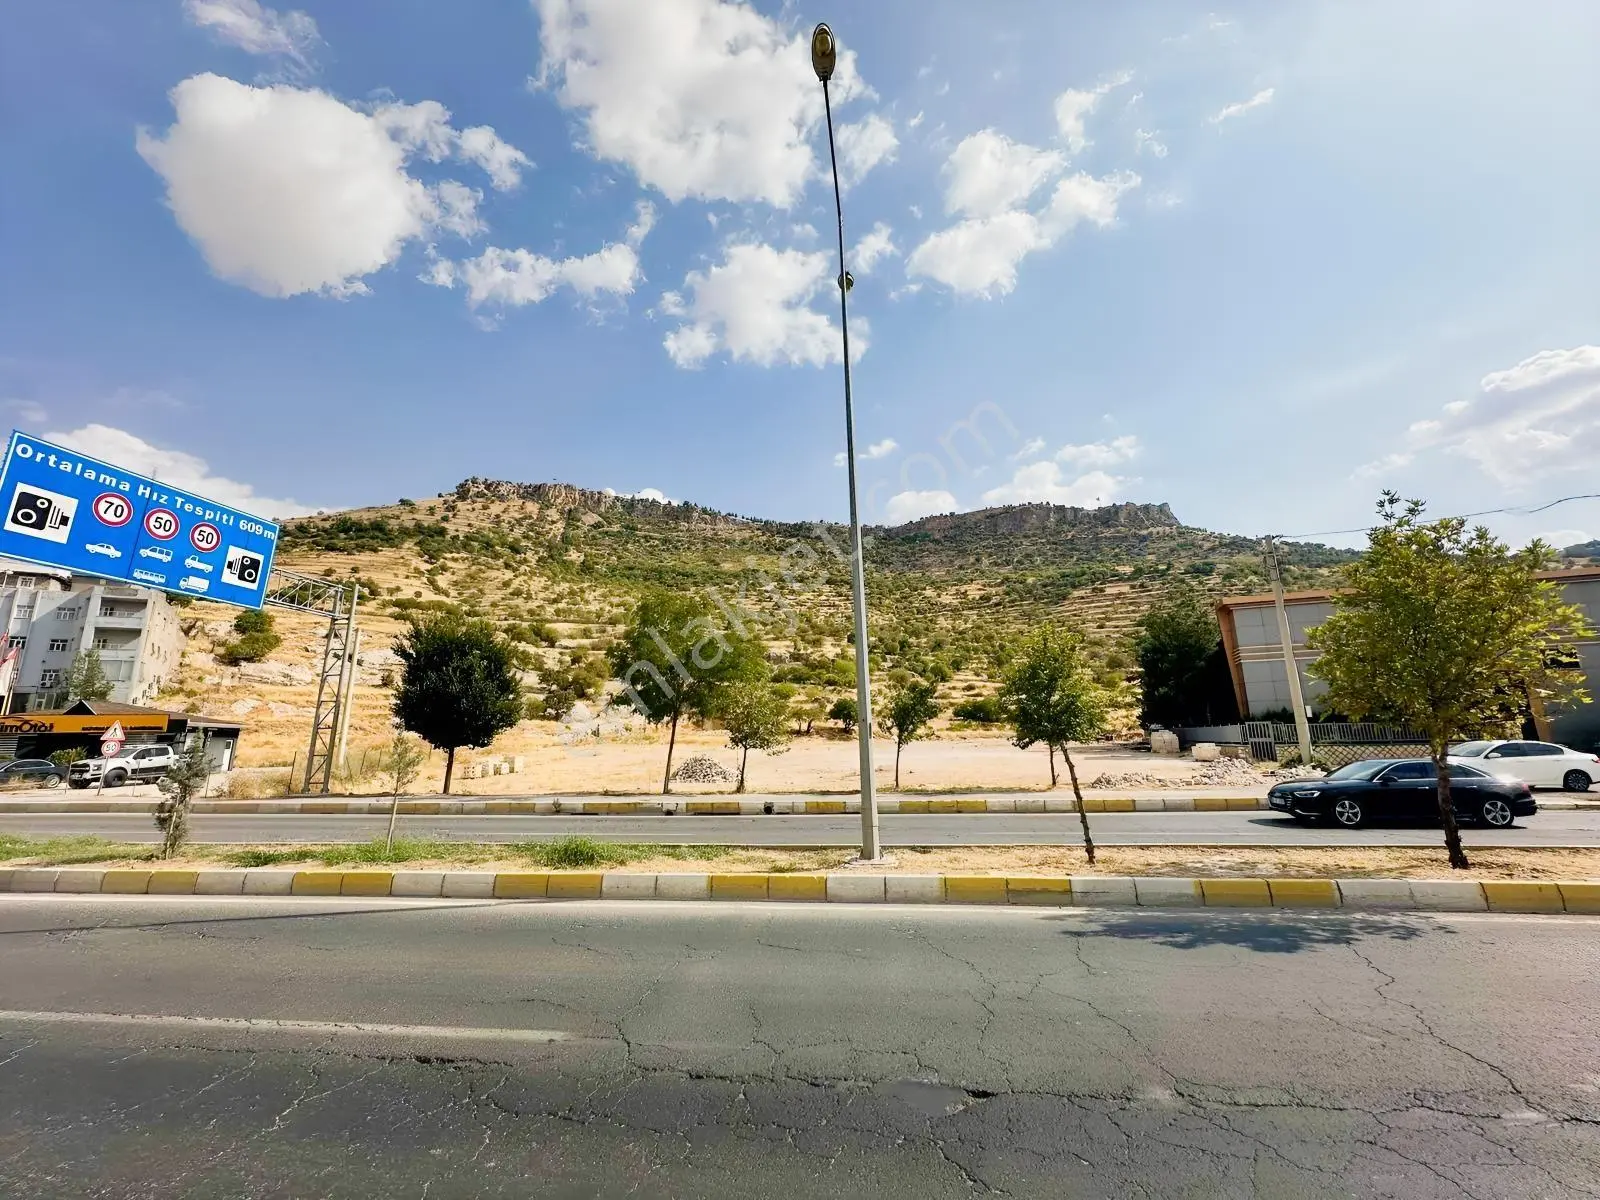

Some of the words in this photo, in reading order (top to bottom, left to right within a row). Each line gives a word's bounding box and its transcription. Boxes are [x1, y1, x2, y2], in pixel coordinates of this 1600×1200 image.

[16, 443, 131, 492] Ortalama
[103, 500, 125, 518] 70
[153, 516, 172, 533] 50
[196, 529, 214, 545] 50
[105, 743, 117, 752] 50
